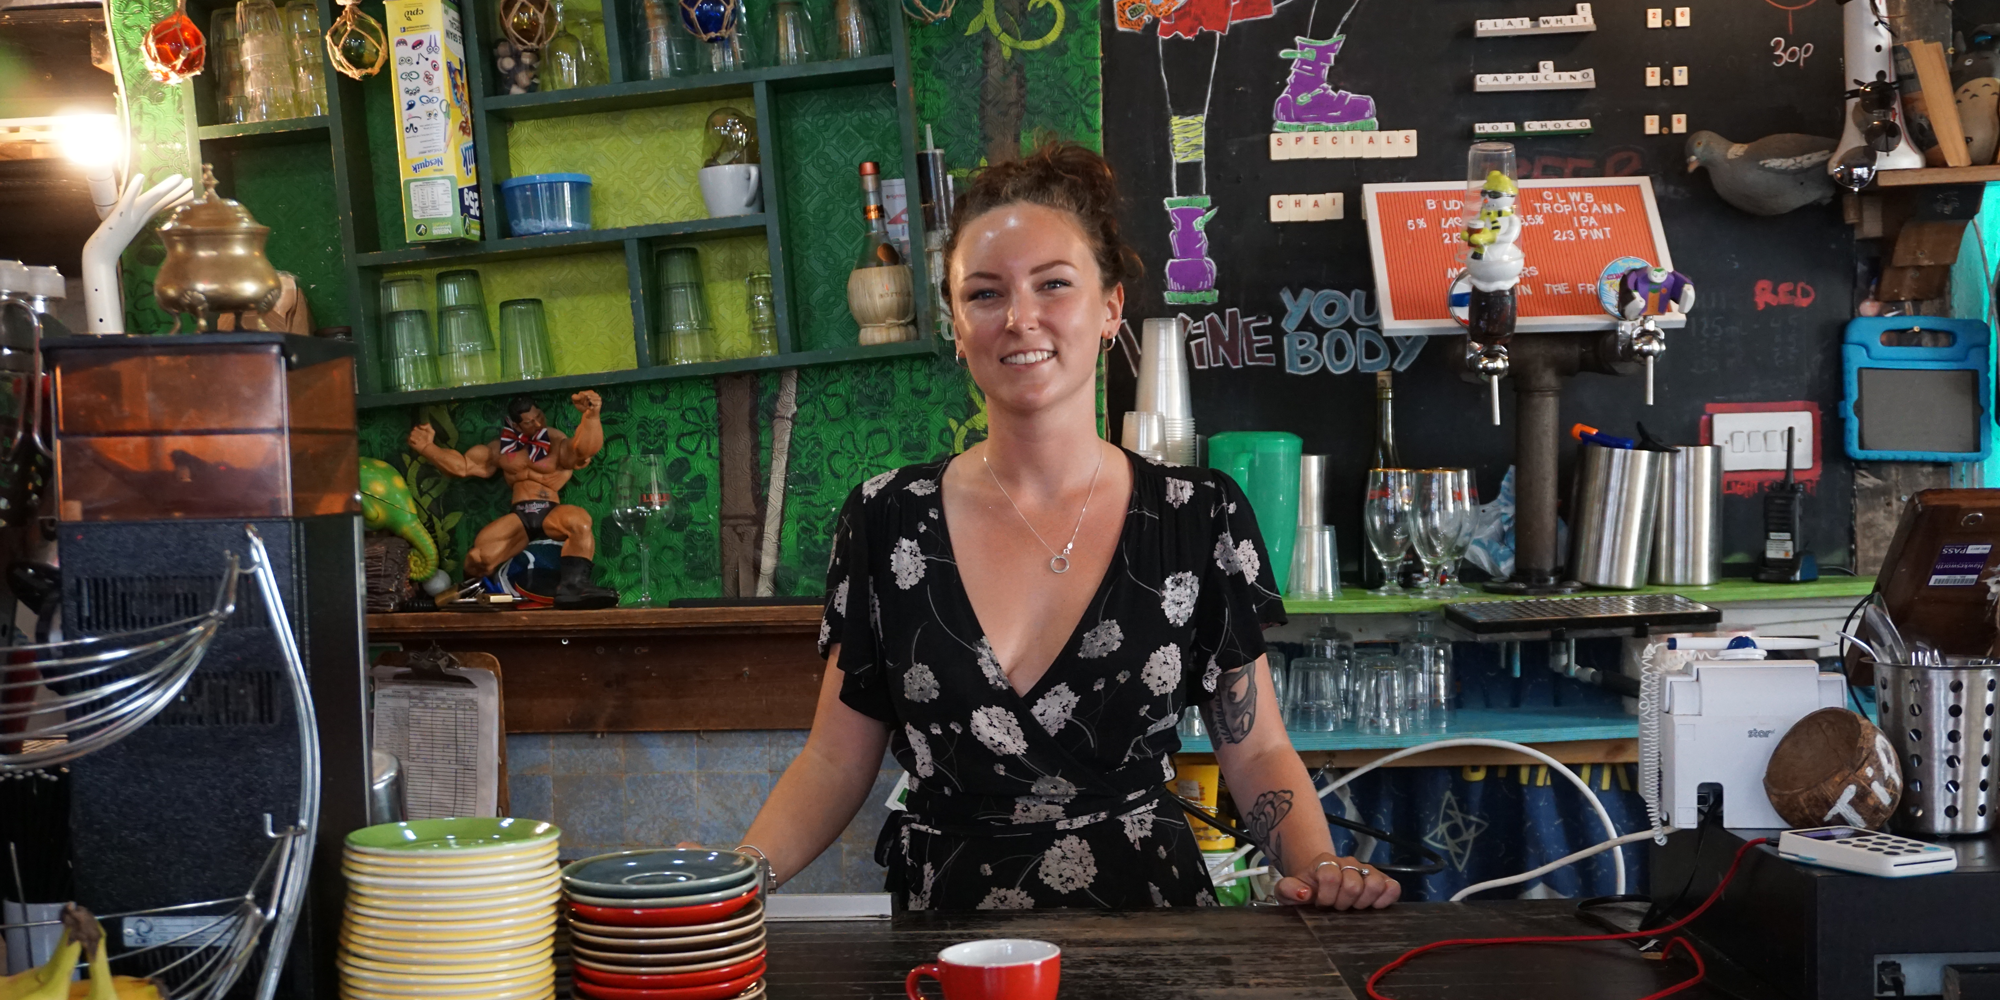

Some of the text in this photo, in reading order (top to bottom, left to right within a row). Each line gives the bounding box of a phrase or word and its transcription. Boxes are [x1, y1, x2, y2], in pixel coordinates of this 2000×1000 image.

[1479, 19, 1526, 29] FLAT
[1478, 120, 1588, 133] HOT CHOCO
[1276, 134, 1411, 147] SPECIALS
[411, 156, 444, 173] Nesquik
[1276, 197, 1336, 209] CHAI
[1533, 201, 1626, 215] TROPICANA
[1441, 216, 1463, 229] LAG
[1578, 227, 1611, 240] PINT
[1544, 283, 1572, 296] THE
[1754, 279, 1816, 311] RED
[1284, 327, 1430, 376] BODY
[1747, 728, 1773, 739] star
